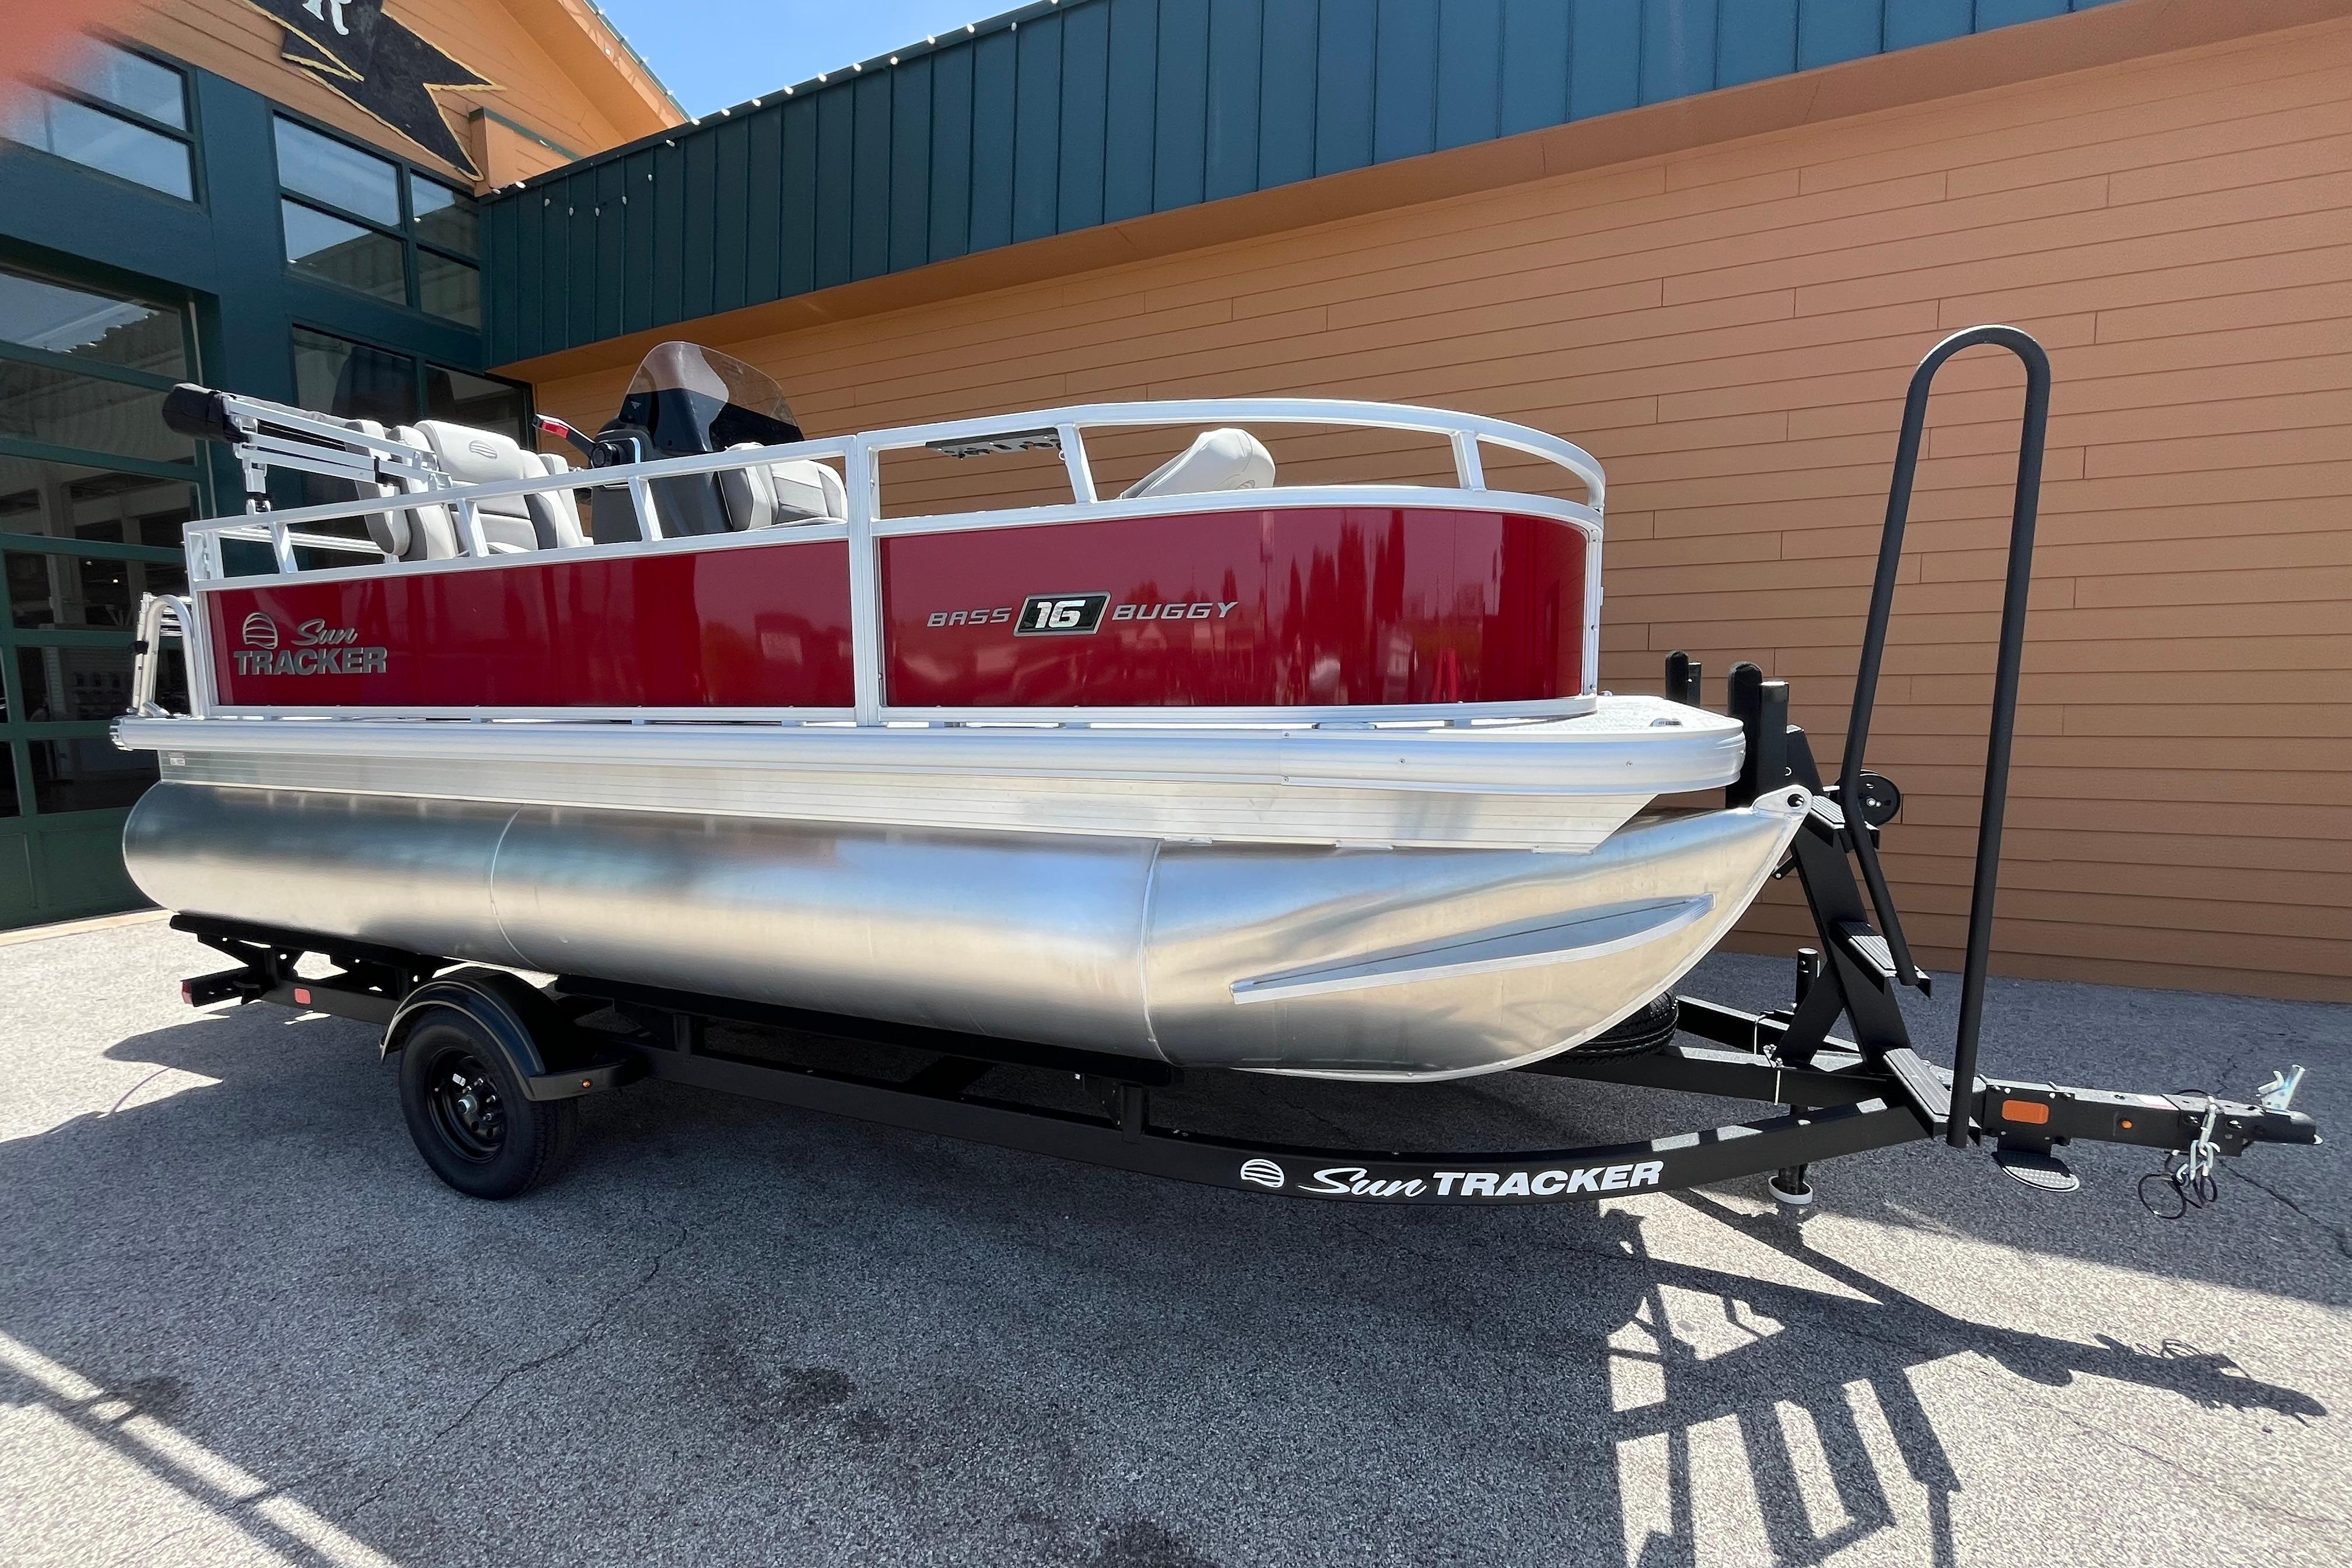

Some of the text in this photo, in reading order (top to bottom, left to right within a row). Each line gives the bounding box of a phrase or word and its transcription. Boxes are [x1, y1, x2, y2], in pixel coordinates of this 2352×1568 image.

[927, 599, 1238, 629] BASS 16 BUGGY
[292, 618, 358, 646] Sun
[233, 646, 387, 676] TRACKER
[1298, 1160, 1664, 1198] Sun TRACKER
